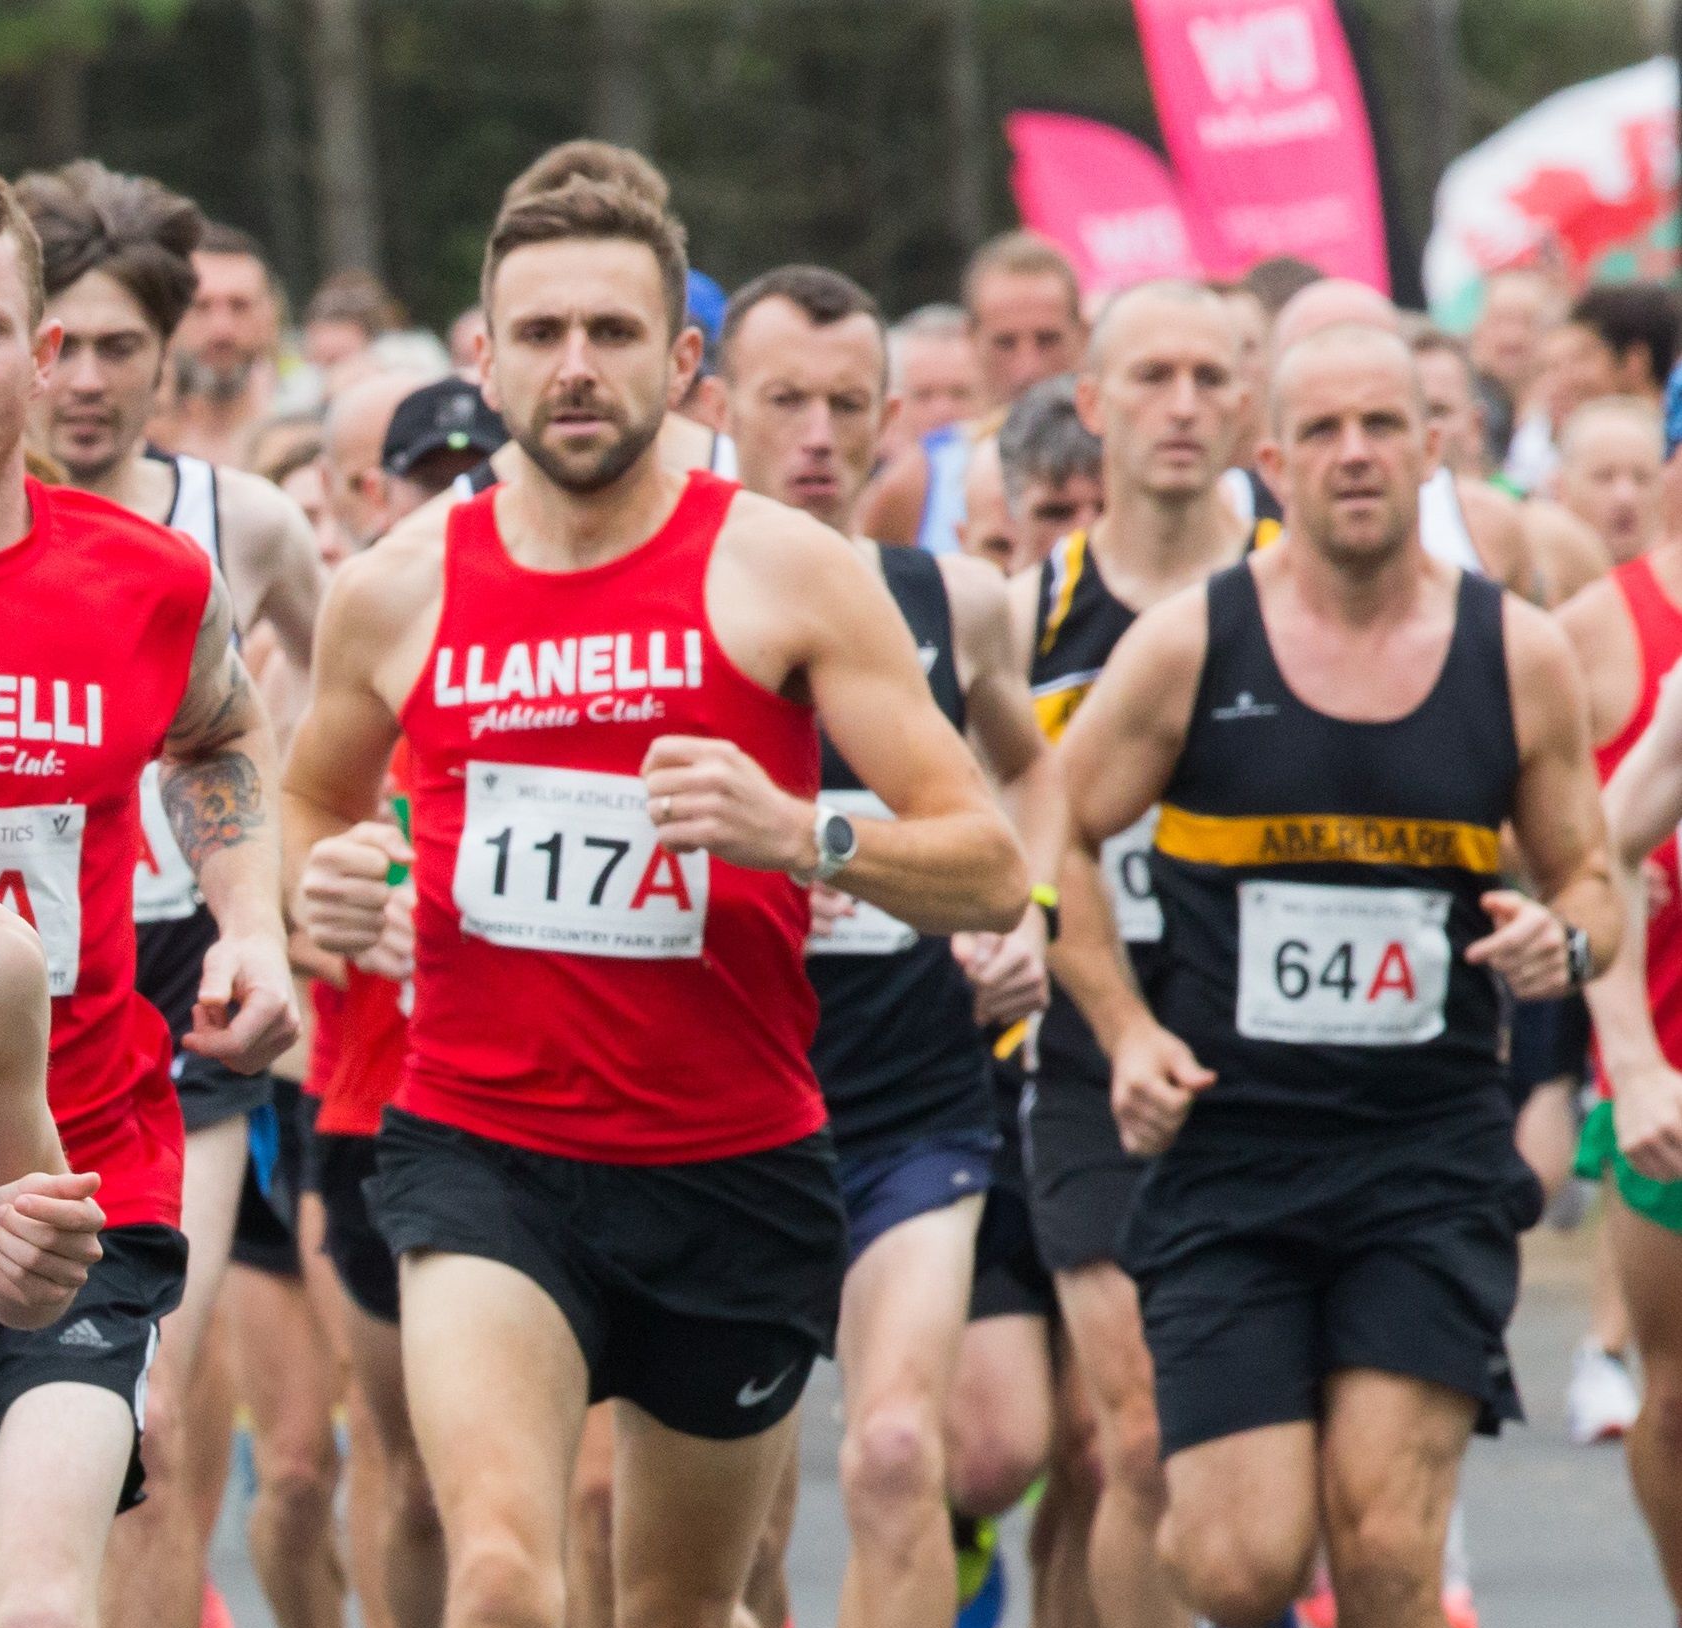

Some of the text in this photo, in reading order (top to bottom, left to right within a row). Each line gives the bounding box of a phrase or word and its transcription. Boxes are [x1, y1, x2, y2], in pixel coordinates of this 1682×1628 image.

[435, 630, 702, 707] LLANELLI
[485, 826, 693, 912] 117A
[1274, 939, 1418, 1003] 64A
